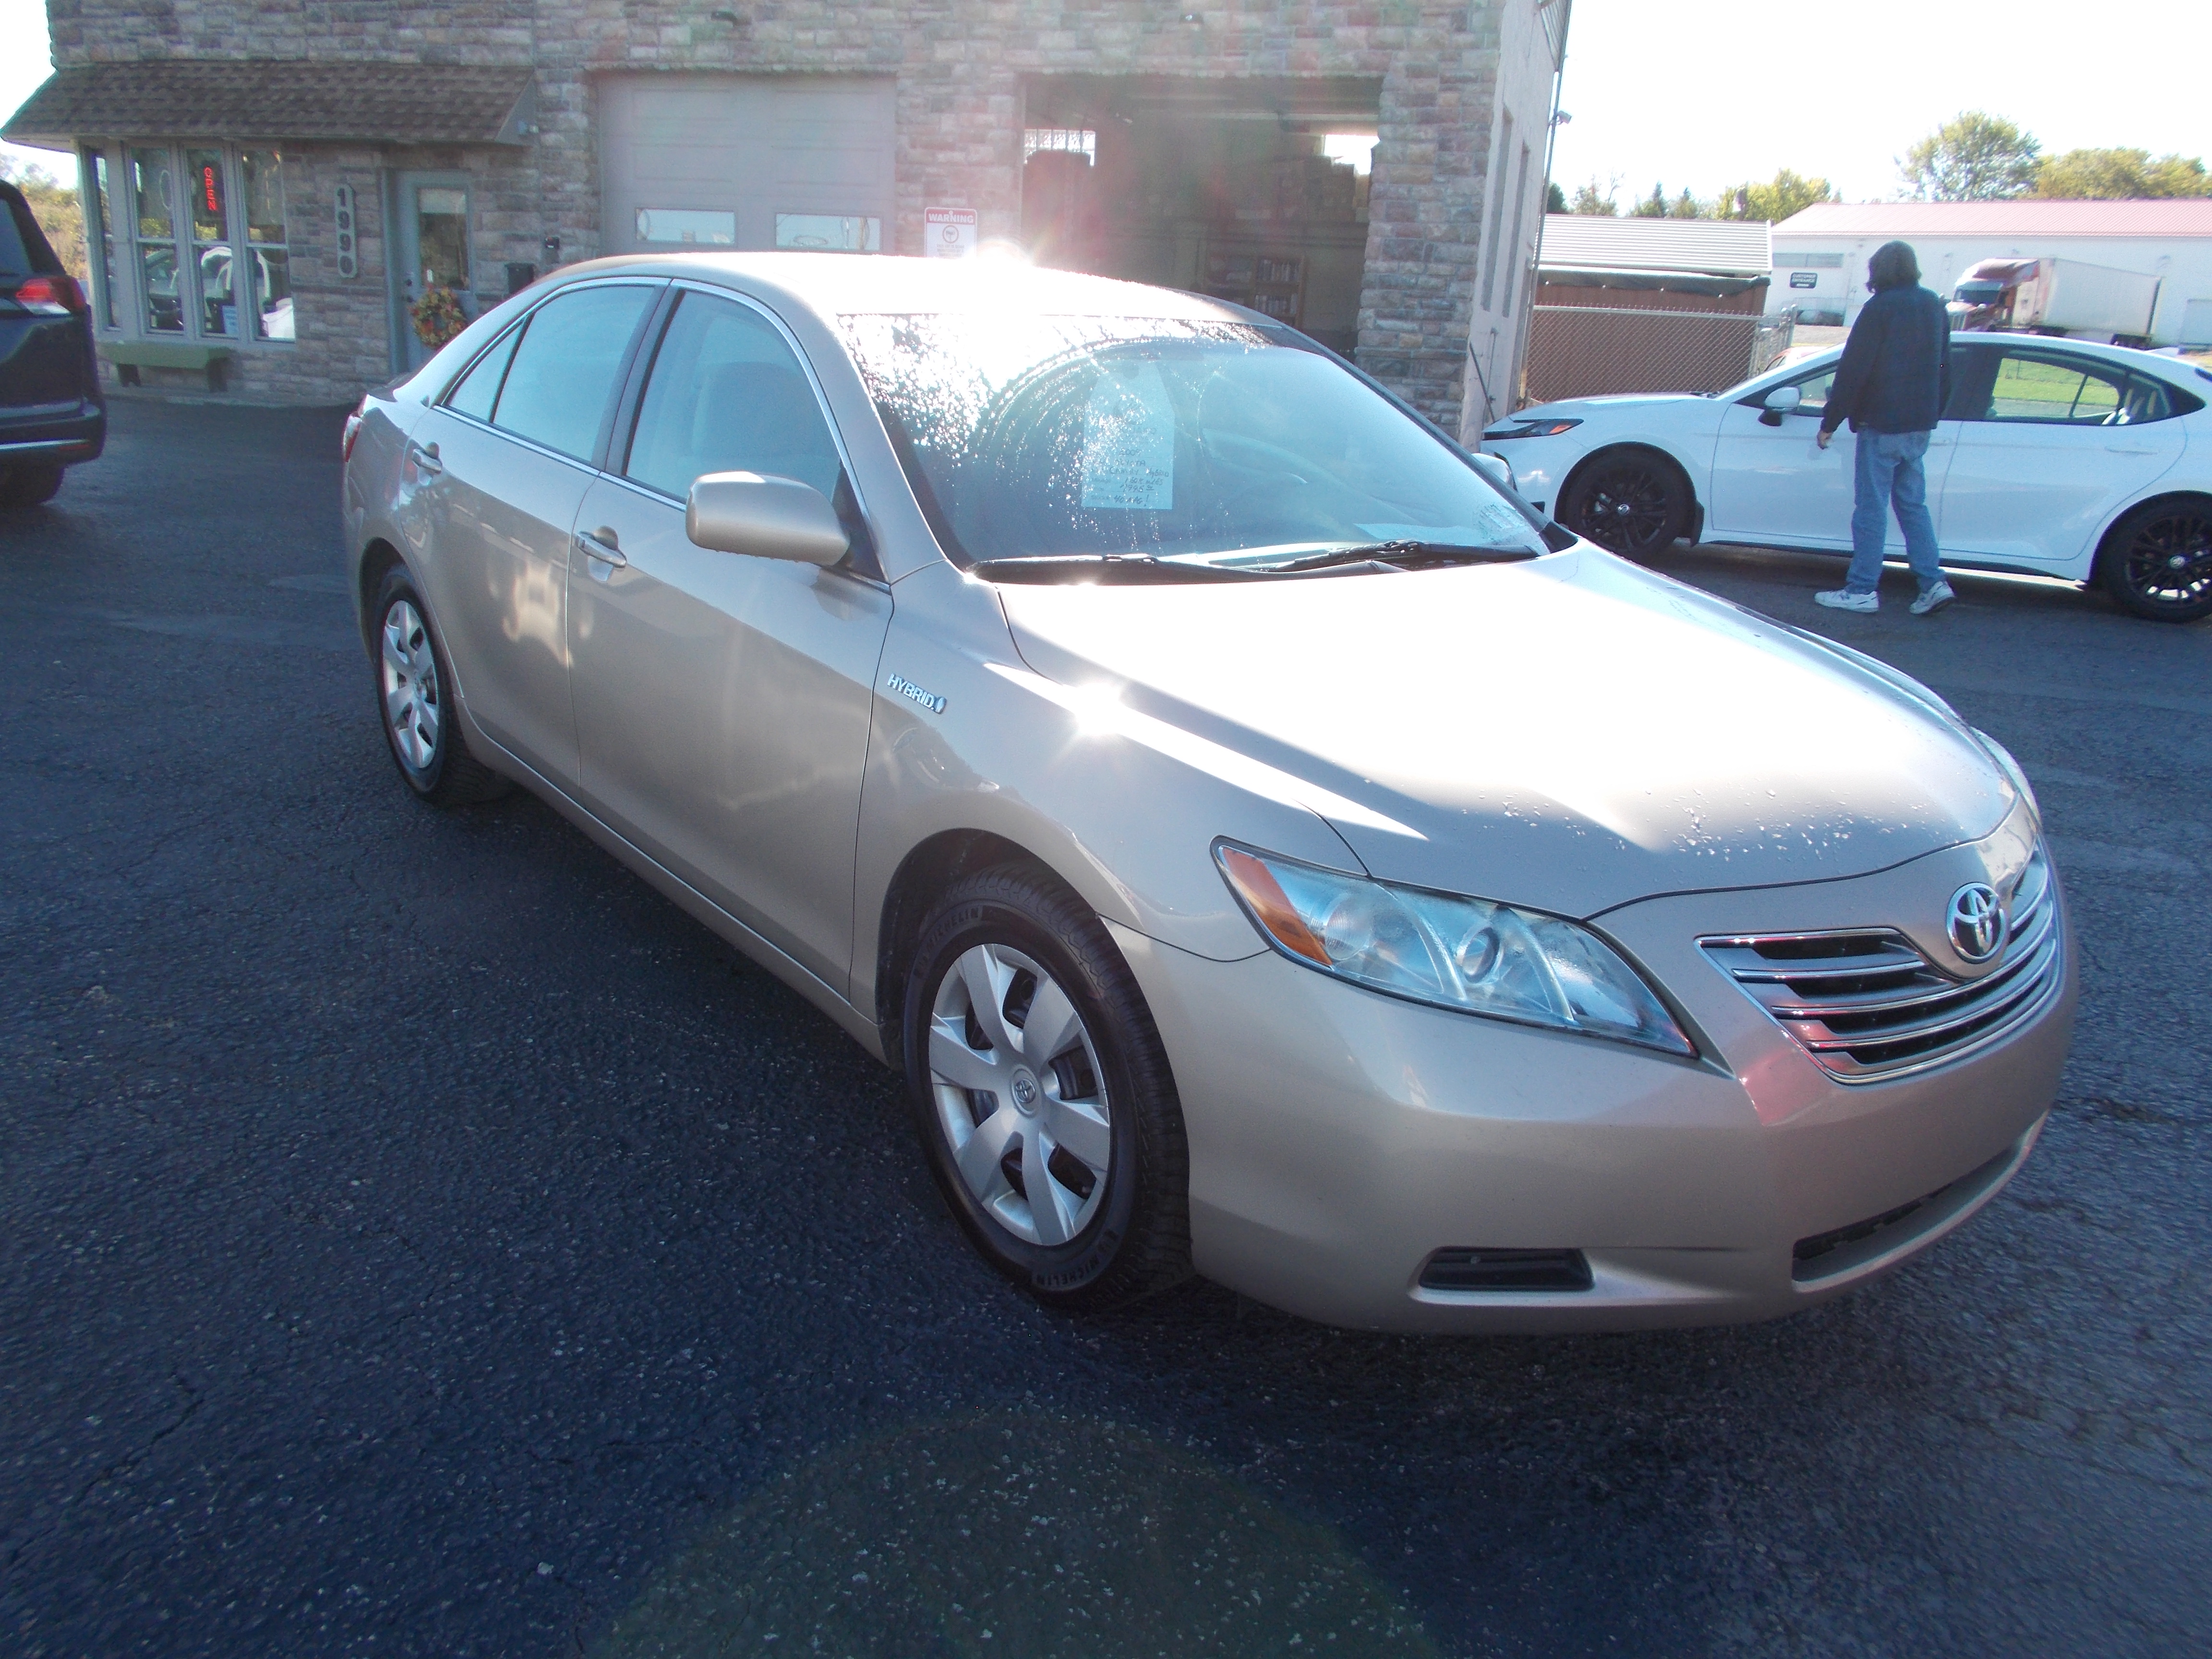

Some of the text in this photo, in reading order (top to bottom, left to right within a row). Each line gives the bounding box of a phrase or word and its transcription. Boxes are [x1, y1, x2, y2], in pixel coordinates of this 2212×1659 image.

[204, 167, 216, 210] OPEN
[337, 188, 353, 274] 1990
[928, 213, 974, 224] WARNING
[887, 673, 935, 709] HYBRID
[1036, 1254, 1100, 1286] MICHELIN
